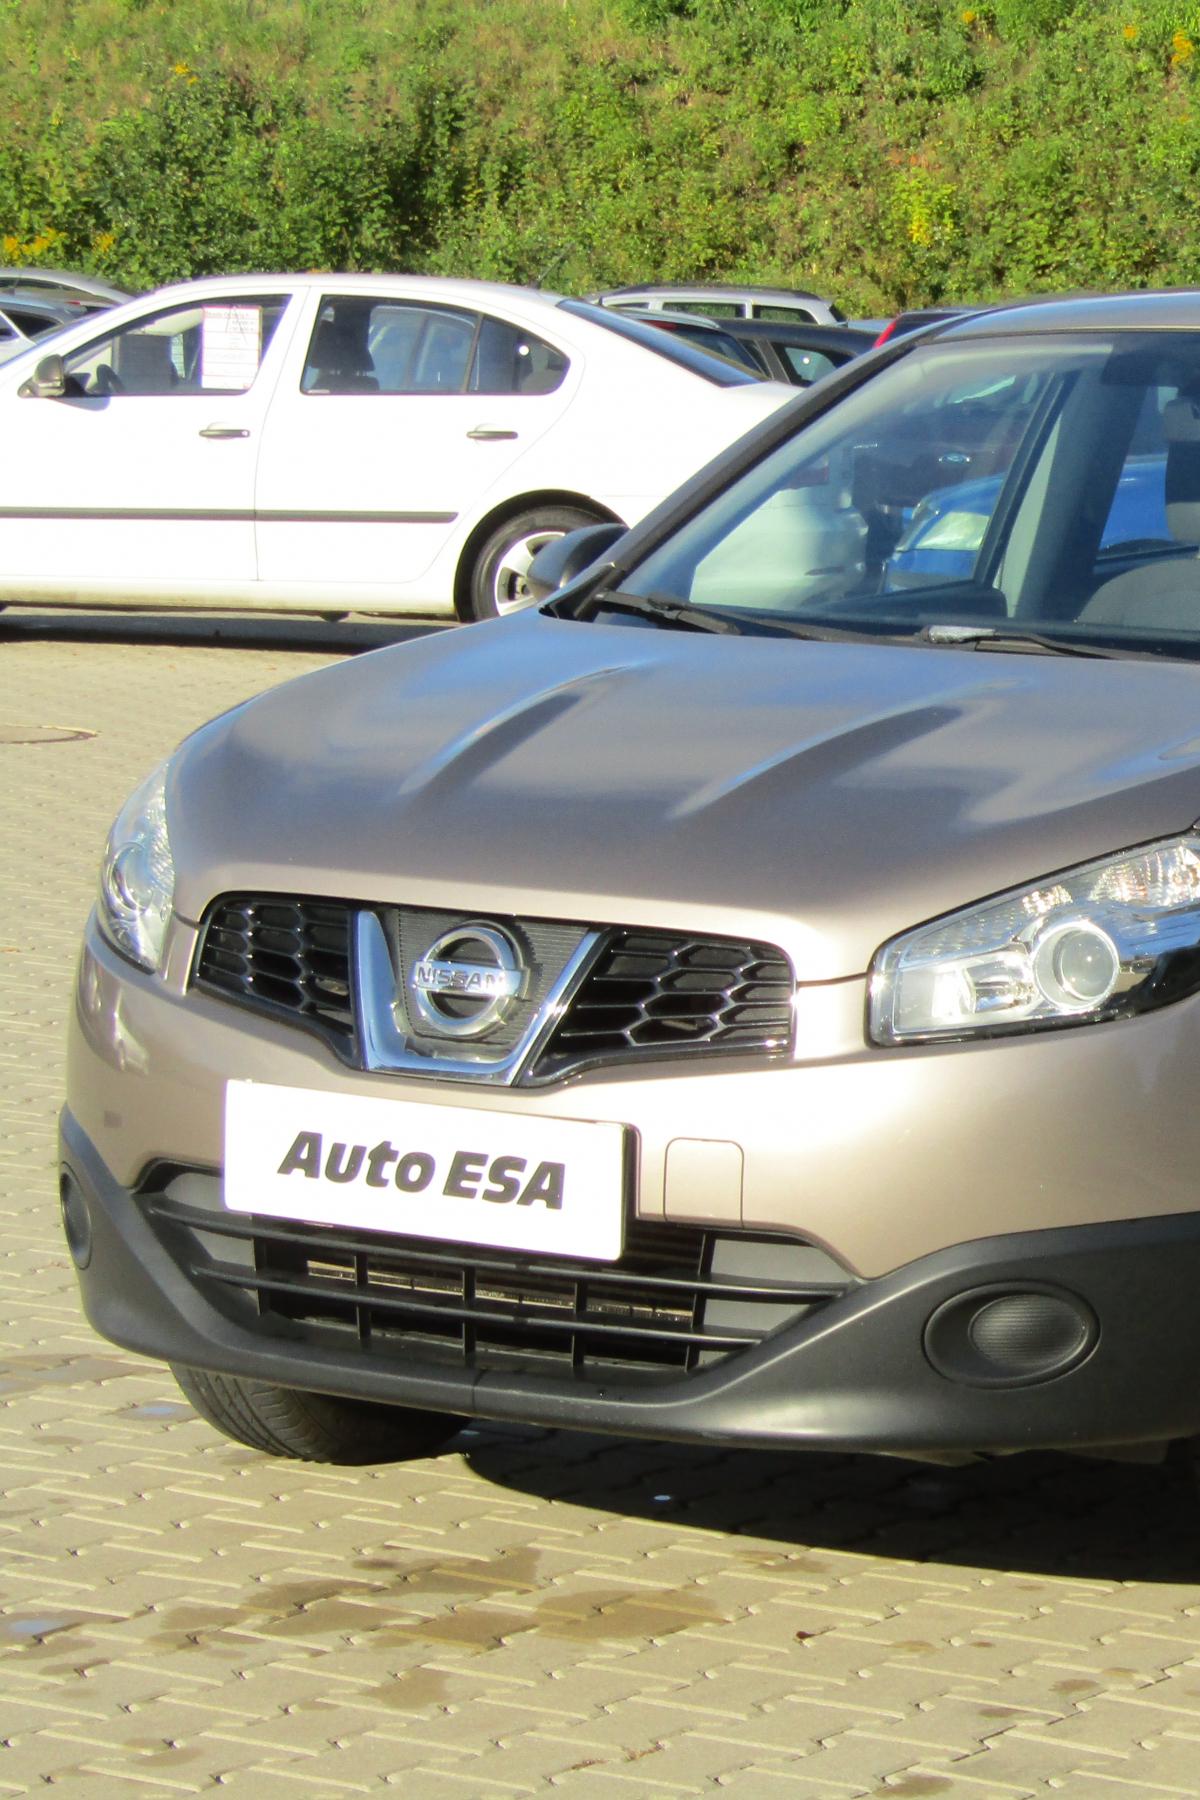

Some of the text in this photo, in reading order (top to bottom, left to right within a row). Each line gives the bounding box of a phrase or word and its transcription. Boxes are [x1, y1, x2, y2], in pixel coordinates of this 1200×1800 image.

[417, 966, 505, 992] NISSAN
[277, 1130, 566, 1211] Auto ESA
